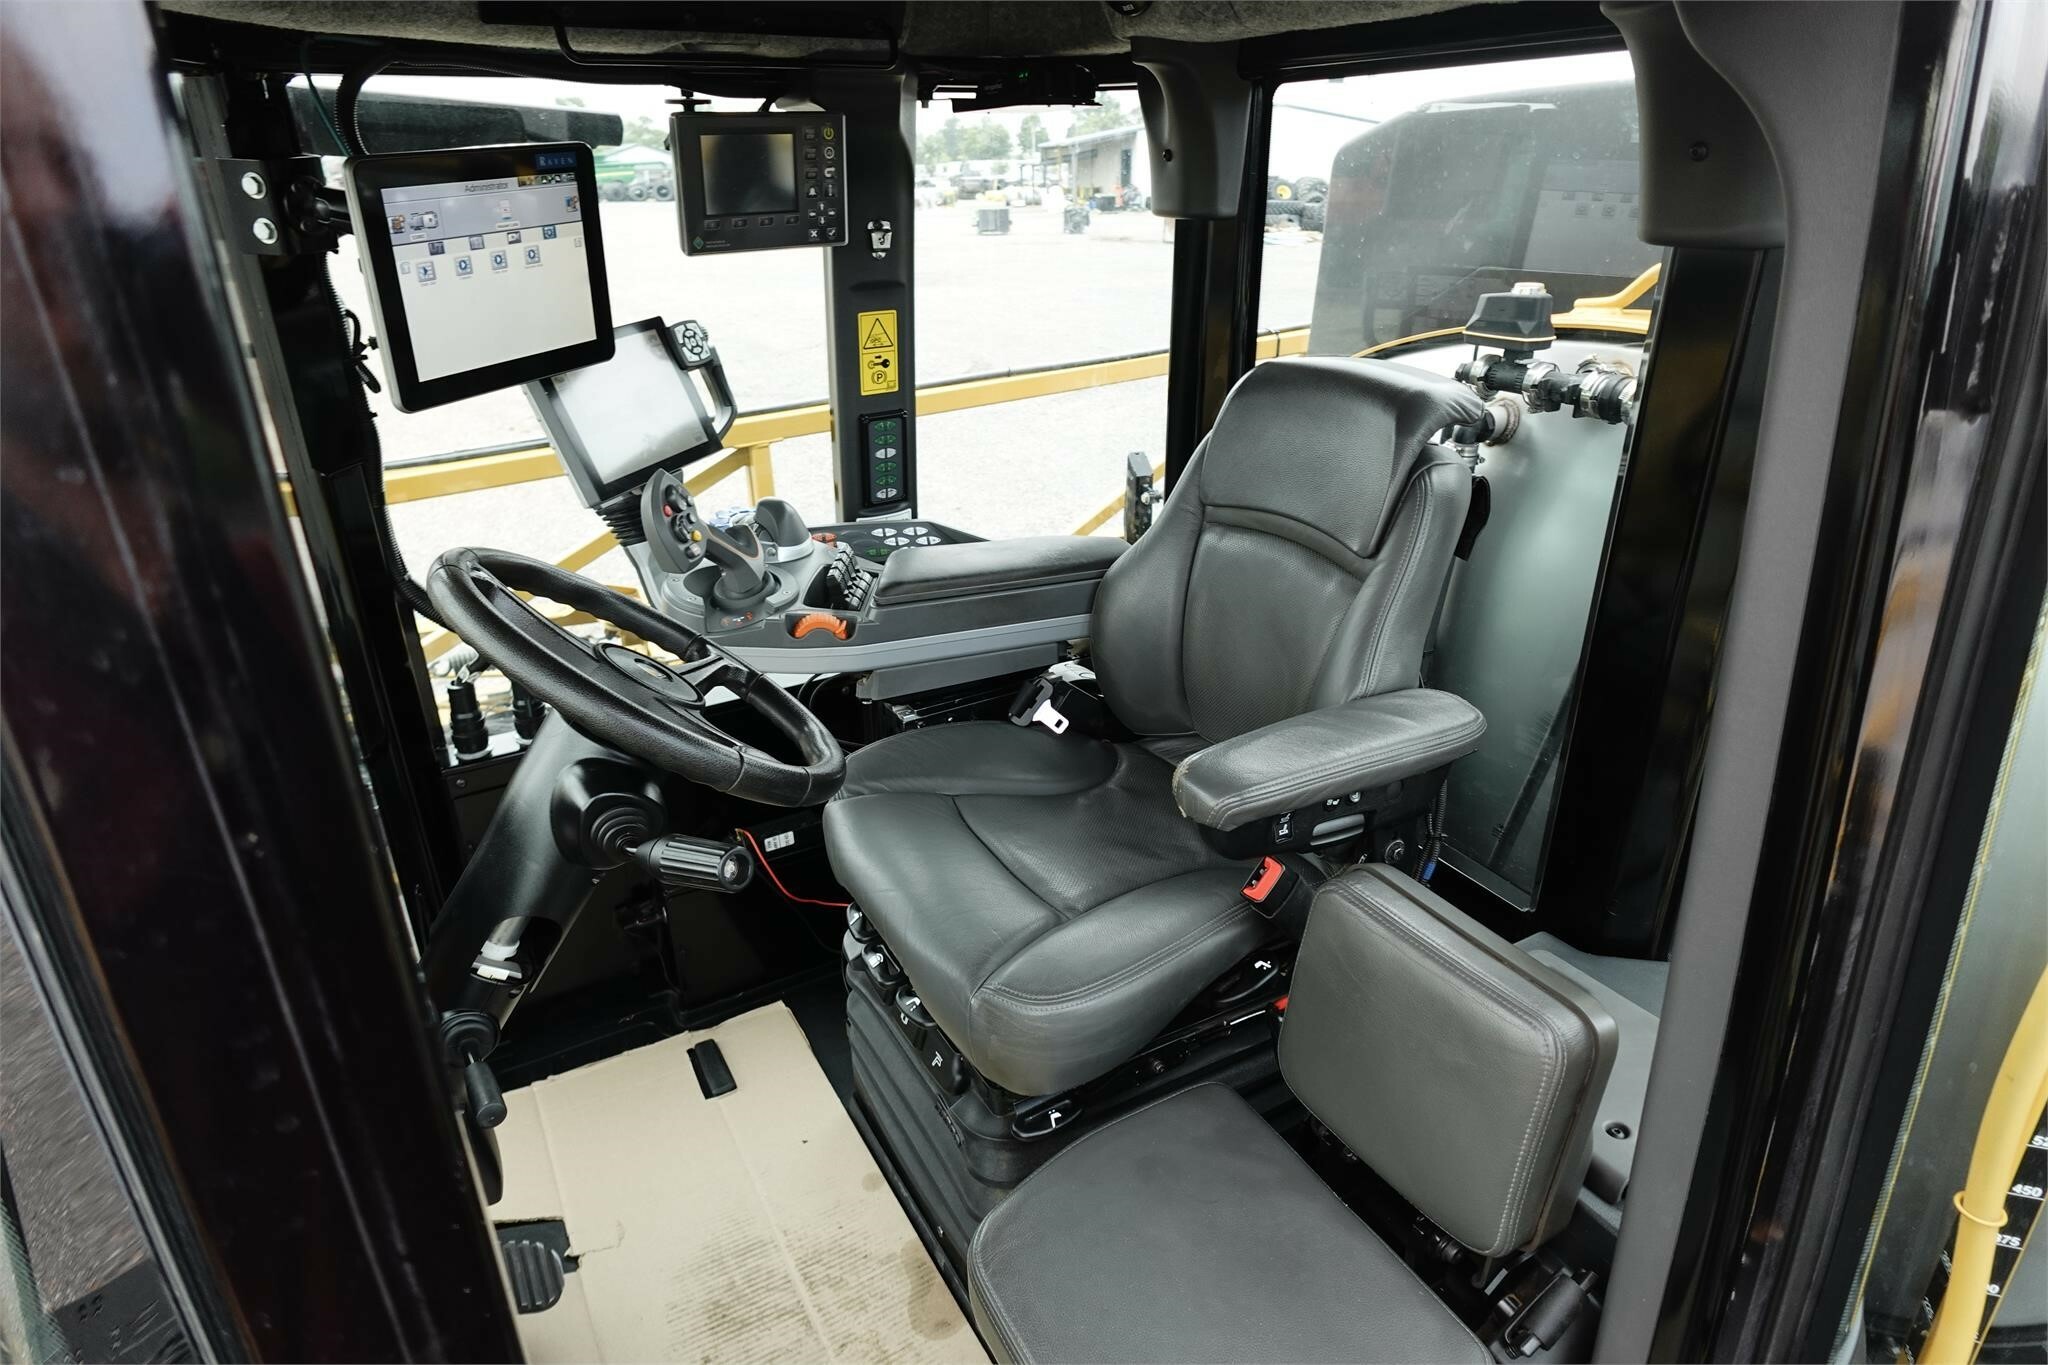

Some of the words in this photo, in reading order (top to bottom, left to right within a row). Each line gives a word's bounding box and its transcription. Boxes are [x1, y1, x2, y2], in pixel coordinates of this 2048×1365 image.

[539, 155, 574, 167] RAVEN
[464, 181, 509, 193] Administrator
[2031, 1135, 2048, 1147] 52
[2012, 1183, 2043, 1198] 450
